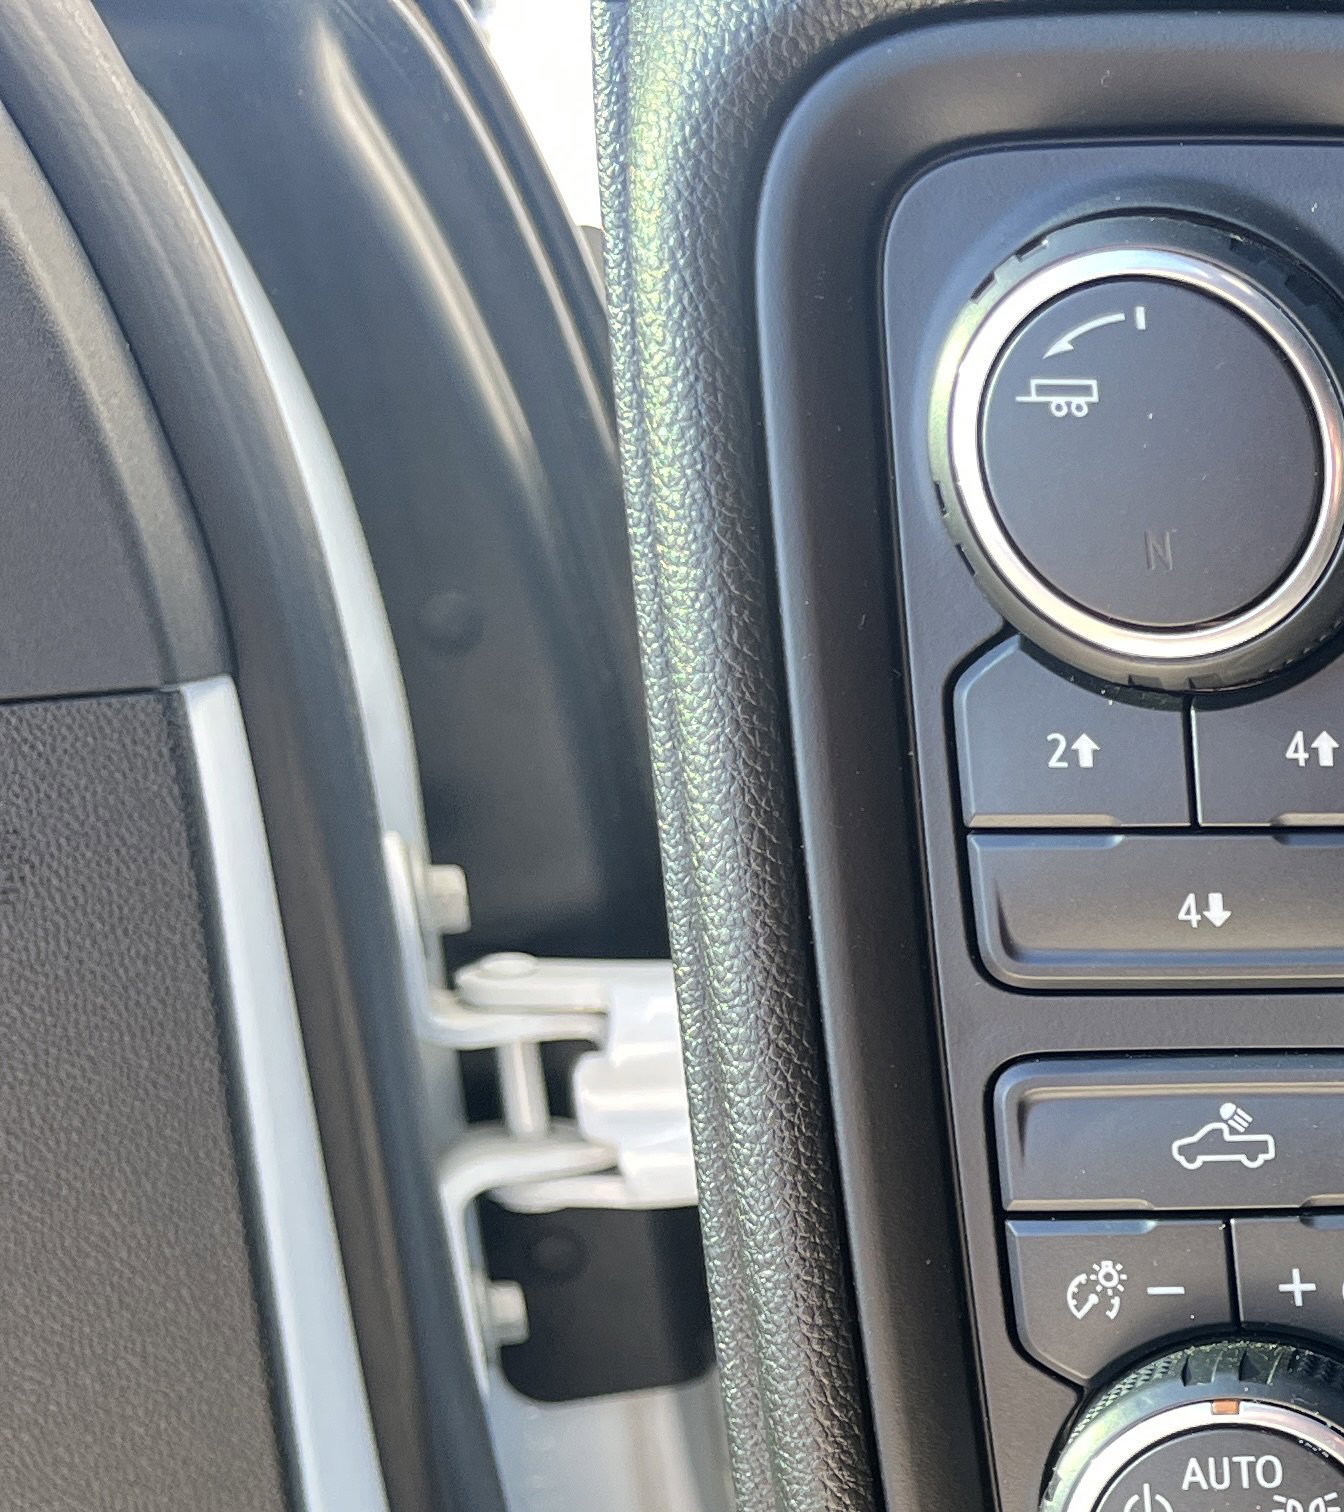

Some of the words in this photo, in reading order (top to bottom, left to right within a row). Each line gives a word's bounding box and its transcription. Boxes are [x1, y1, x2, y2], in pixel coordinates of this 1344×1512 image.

[1047, 733, 1068, 769] 2
[1285, 731, 1309, 767] 4
[1177, 893, 1202, 929] 4
[1182, 1455, 1284, 1491] AUTO
